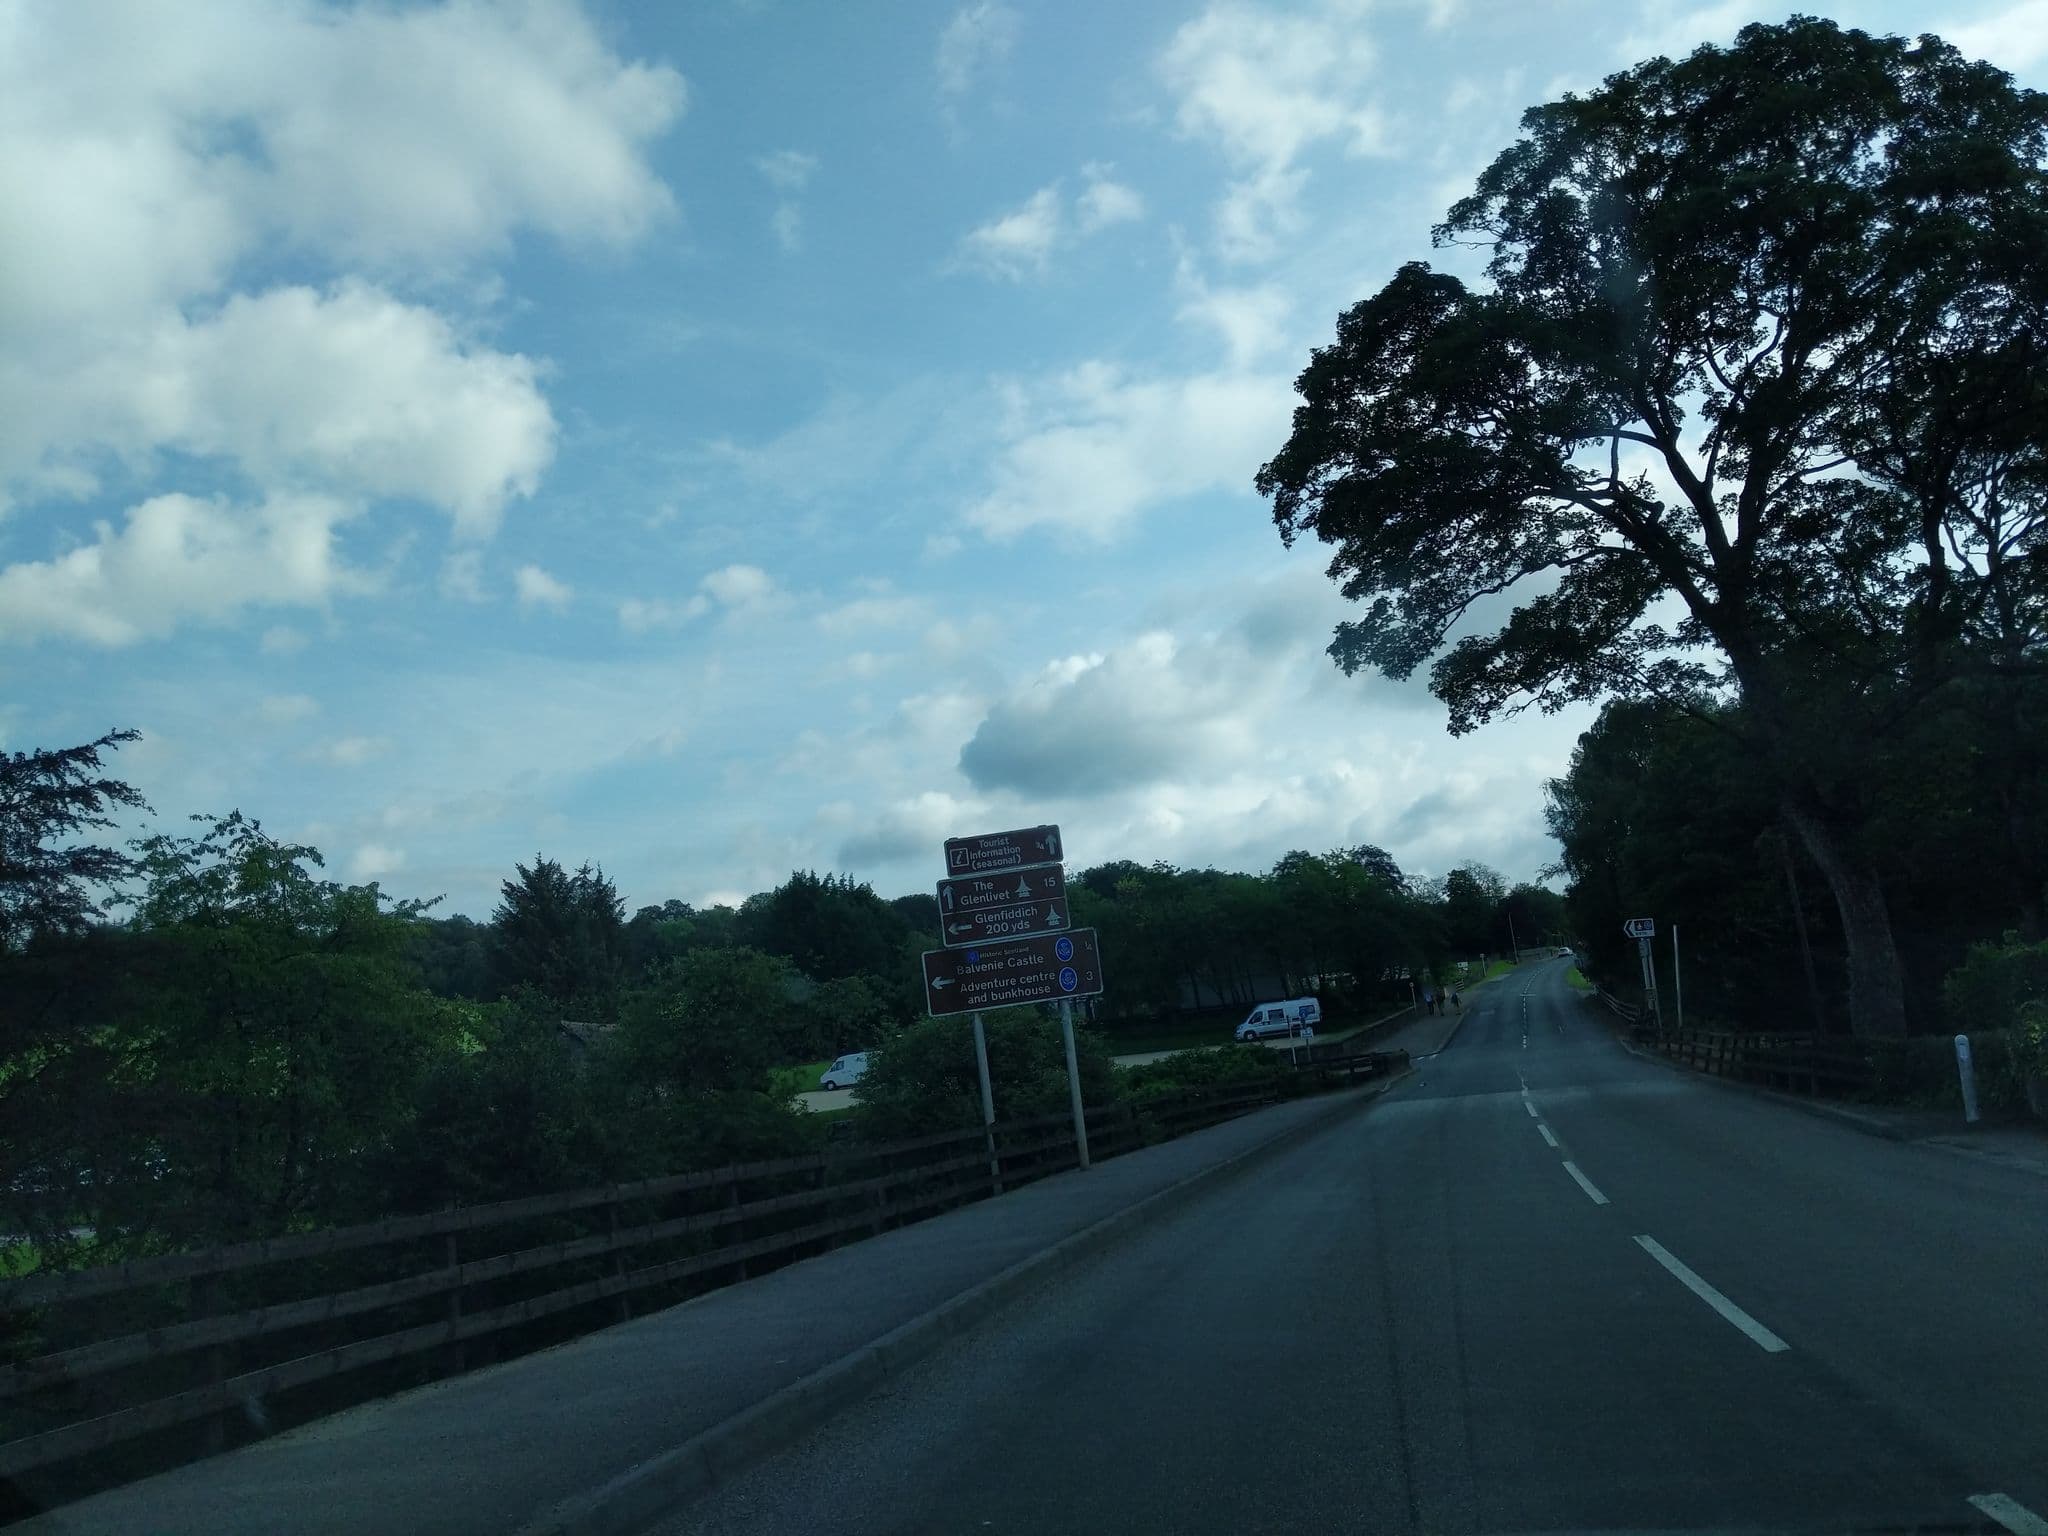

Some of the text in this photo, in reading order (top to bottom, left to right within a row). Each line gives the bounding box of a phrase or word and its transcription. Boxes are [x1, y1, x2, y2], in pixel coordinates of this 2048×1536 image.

[979, 836, 1009, 849] Tourist
[970, 845, 1021, 860] Information
[972, 854, 1021, 870] (seasonal)
[974, 881, 994, 892] The
[1044, 877, 1056, 888] 15
[960, 890, 1010, 906] Glenlivet
[975, 905, 1038, 924] Glenfiddich
[986, 920, 1031, 935] 200 yds
[957, 954, 1044, 975] Balvenie Castle
[960, 971, 1056, 993] Adventure centre
[1086, 970, 1094, 981] 3
[967, 985, 1051, 1005] and bunkhouse
